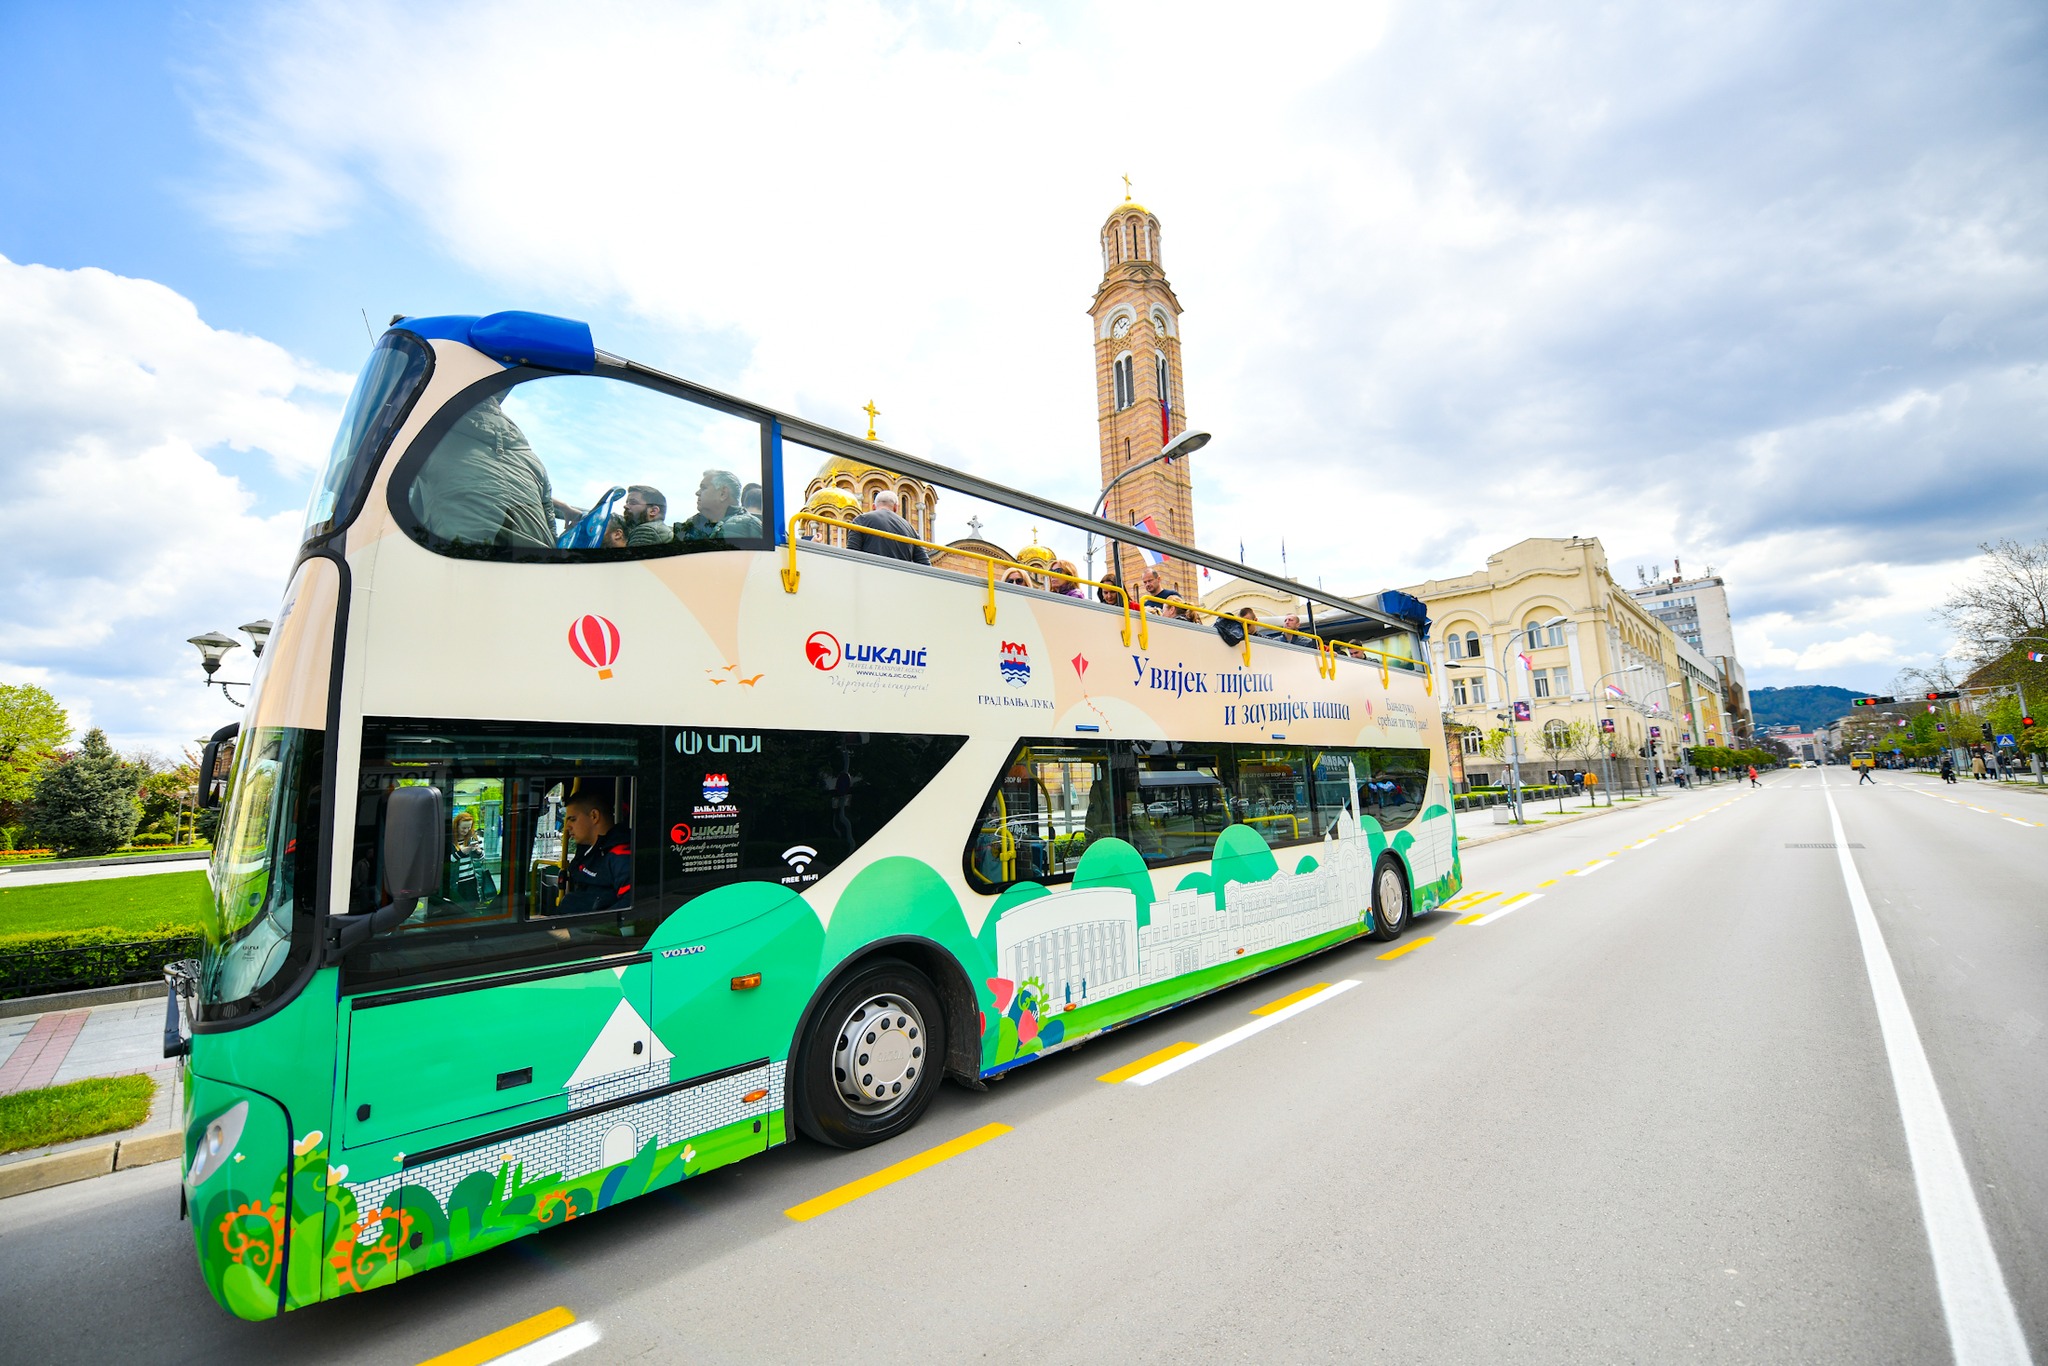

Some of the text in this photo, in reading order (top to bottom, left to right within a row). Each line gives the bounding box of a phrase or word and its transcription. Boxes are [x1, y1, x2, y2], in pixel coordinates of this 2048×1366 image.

[845, 643, 927, 667] LUKAJIĆ
[1131, 654, 1273, 699] Увијек лијепа
[978, 695, 1055, 710] ГРАД БАЊА ЛУКА
[1224, 695, 1351, 731] и заувијек наша
[694, 804, 737, 813] БАЊА ЛУКА
[781, 875, 800, 884] FREE
[661, 944, 706, 959] VOLVO
